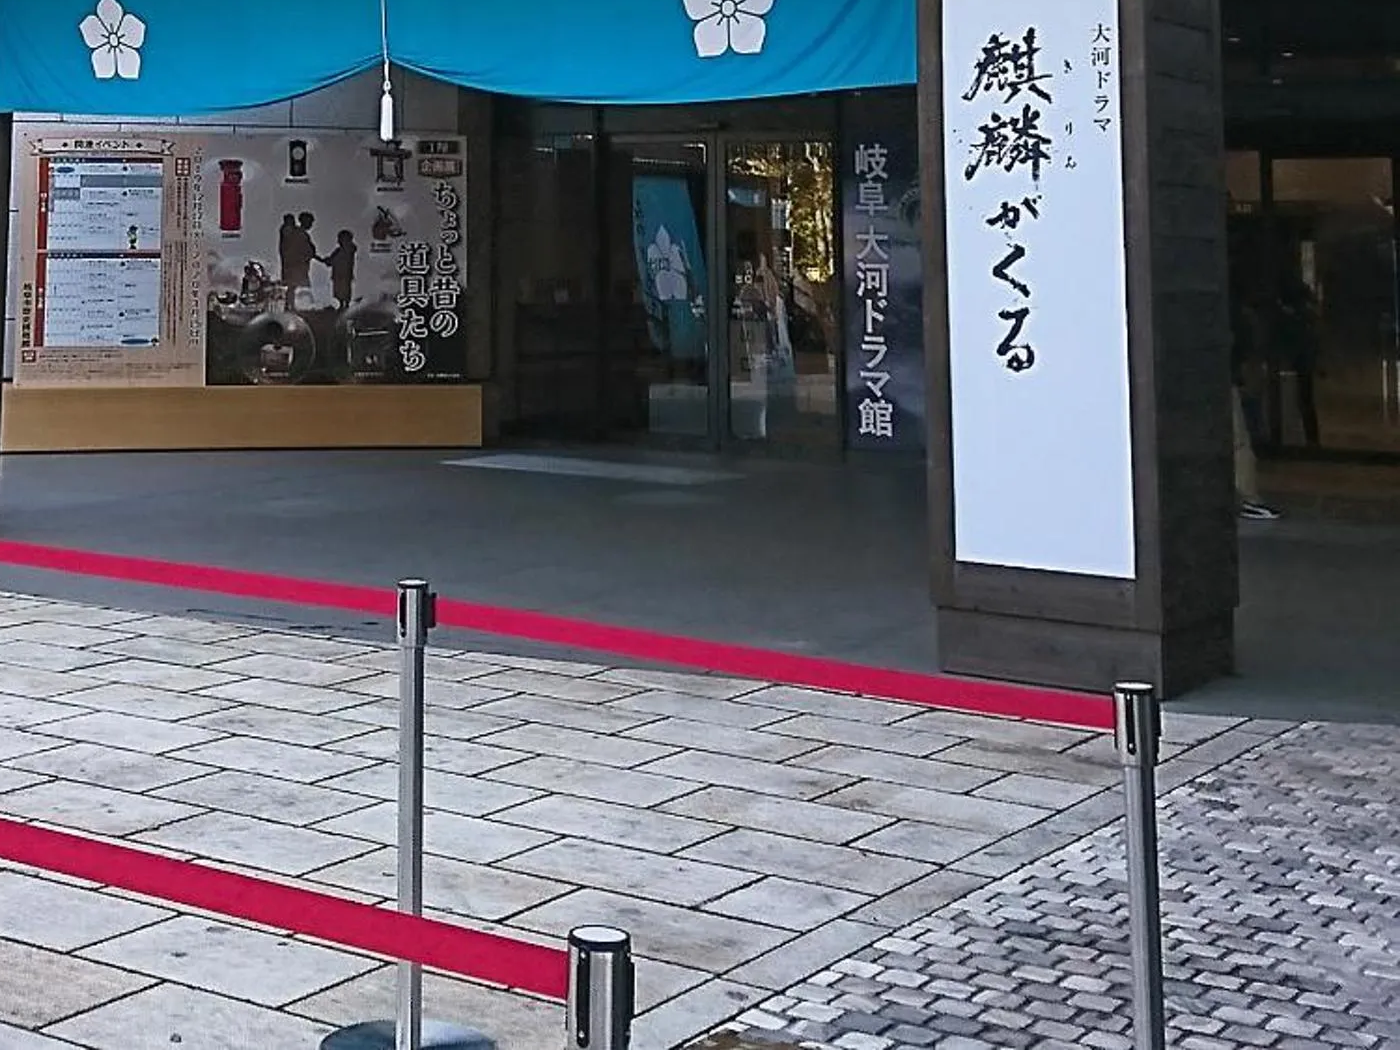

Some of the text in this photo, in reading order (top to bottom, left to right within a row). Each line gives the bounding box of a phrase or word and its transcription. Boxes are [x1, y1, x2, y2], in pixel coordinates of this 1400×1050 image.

[1091, 23, 1112, 134] 大河ドラマ
[428, 180, 461, 338] ちょっと昔の
[961, 26, 1052, 372] 麒麟がくる
[396, 242, 430, 371] 道具たち
